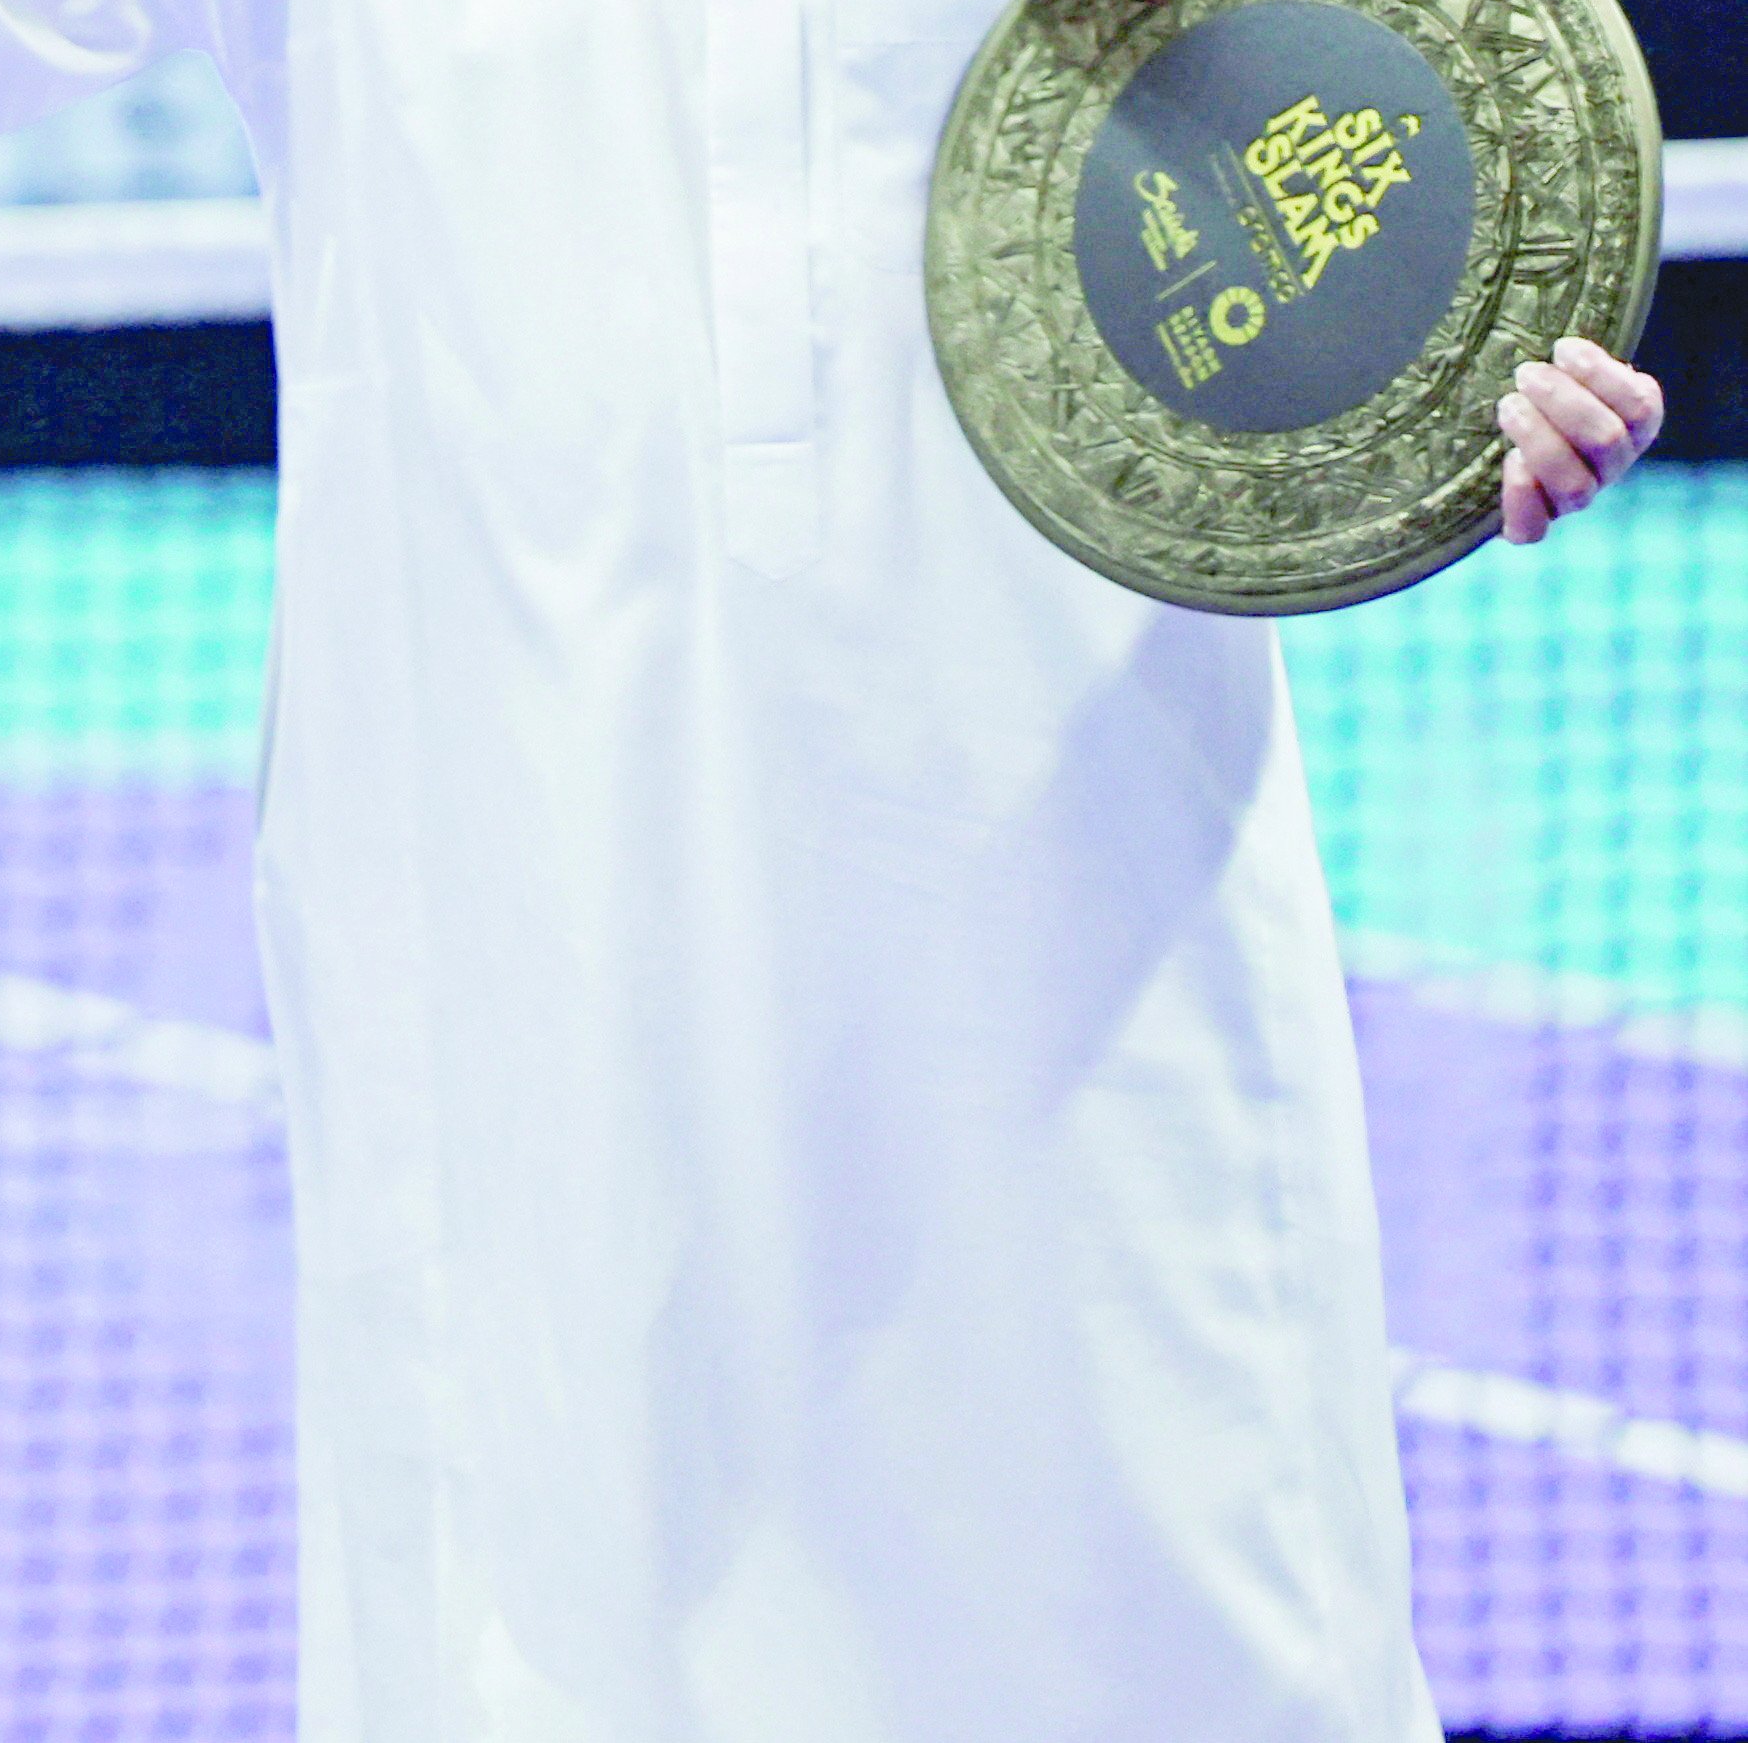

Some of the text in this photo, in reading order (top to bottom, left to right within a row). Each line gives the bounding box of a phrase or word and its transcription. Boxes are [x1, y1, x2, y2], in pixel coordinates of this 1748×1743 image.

[1243, 132, 1340, 290] SLAM
[1266, 94, 1381, 250] KINGS
[1332, 106, 1413, 209] SIX
